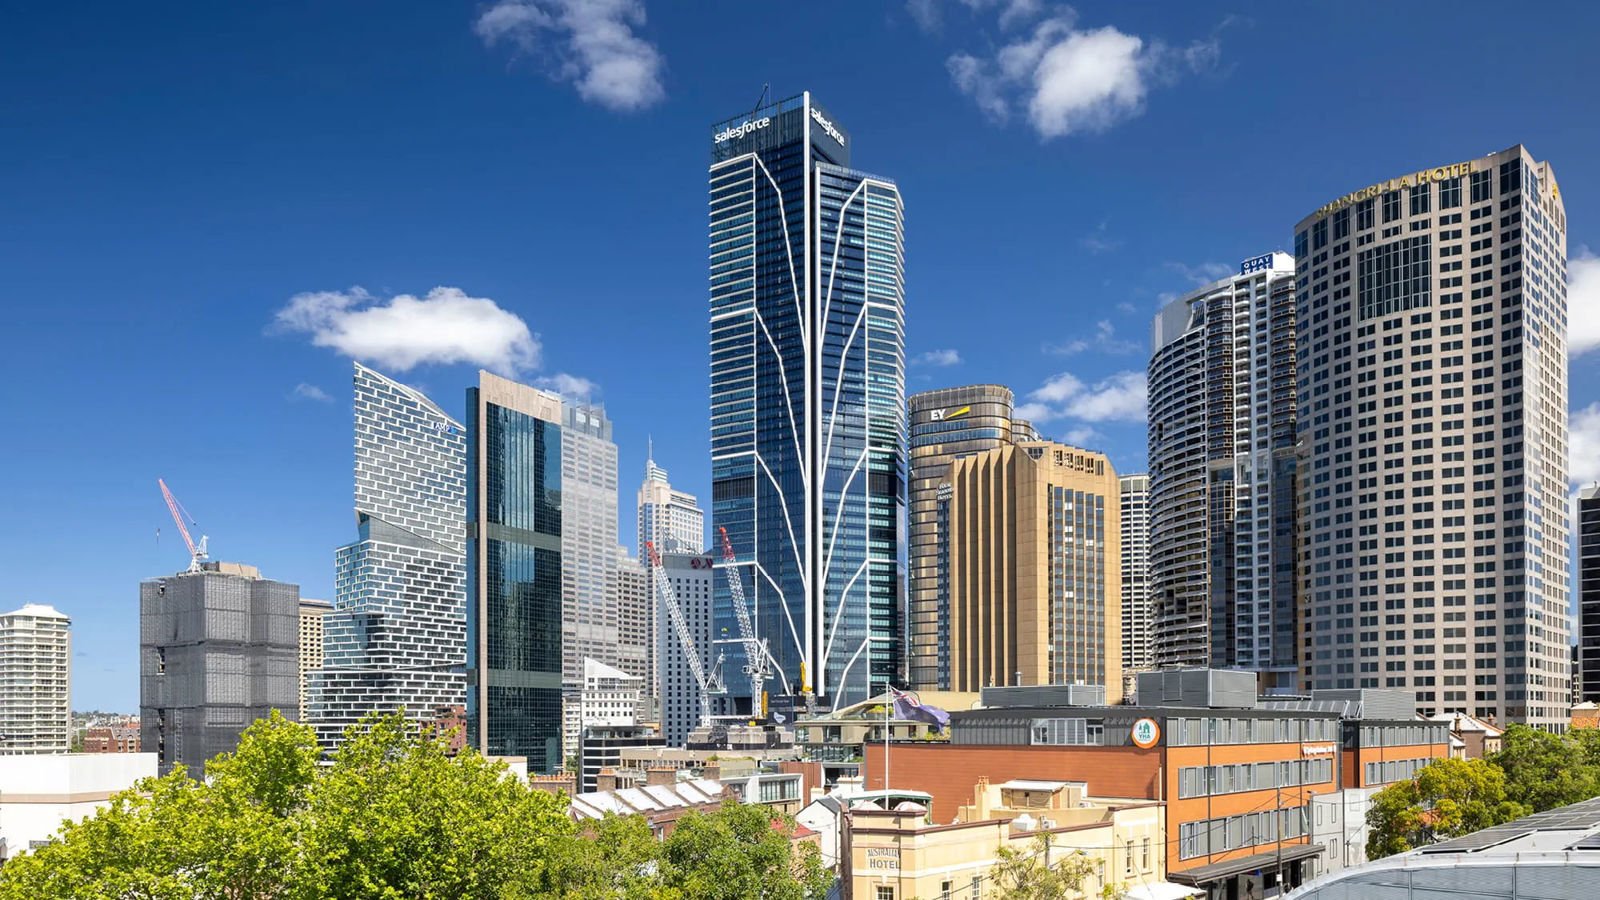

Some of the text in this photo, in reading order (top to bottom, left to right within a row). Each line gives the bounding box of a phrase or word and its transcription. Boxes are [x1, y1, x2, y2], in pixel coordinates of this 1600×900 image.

[714, 117, 770, 144] salesforce
[810, 107, 845, 147] salesforce
[1315, 160, 1479, 220] SHANGRI-LA HOTEL
[1243, 255, 1270, 269] QUAY
[930, 409, 945, 421] EY
[869, 859, 901, 869] HOTEL
